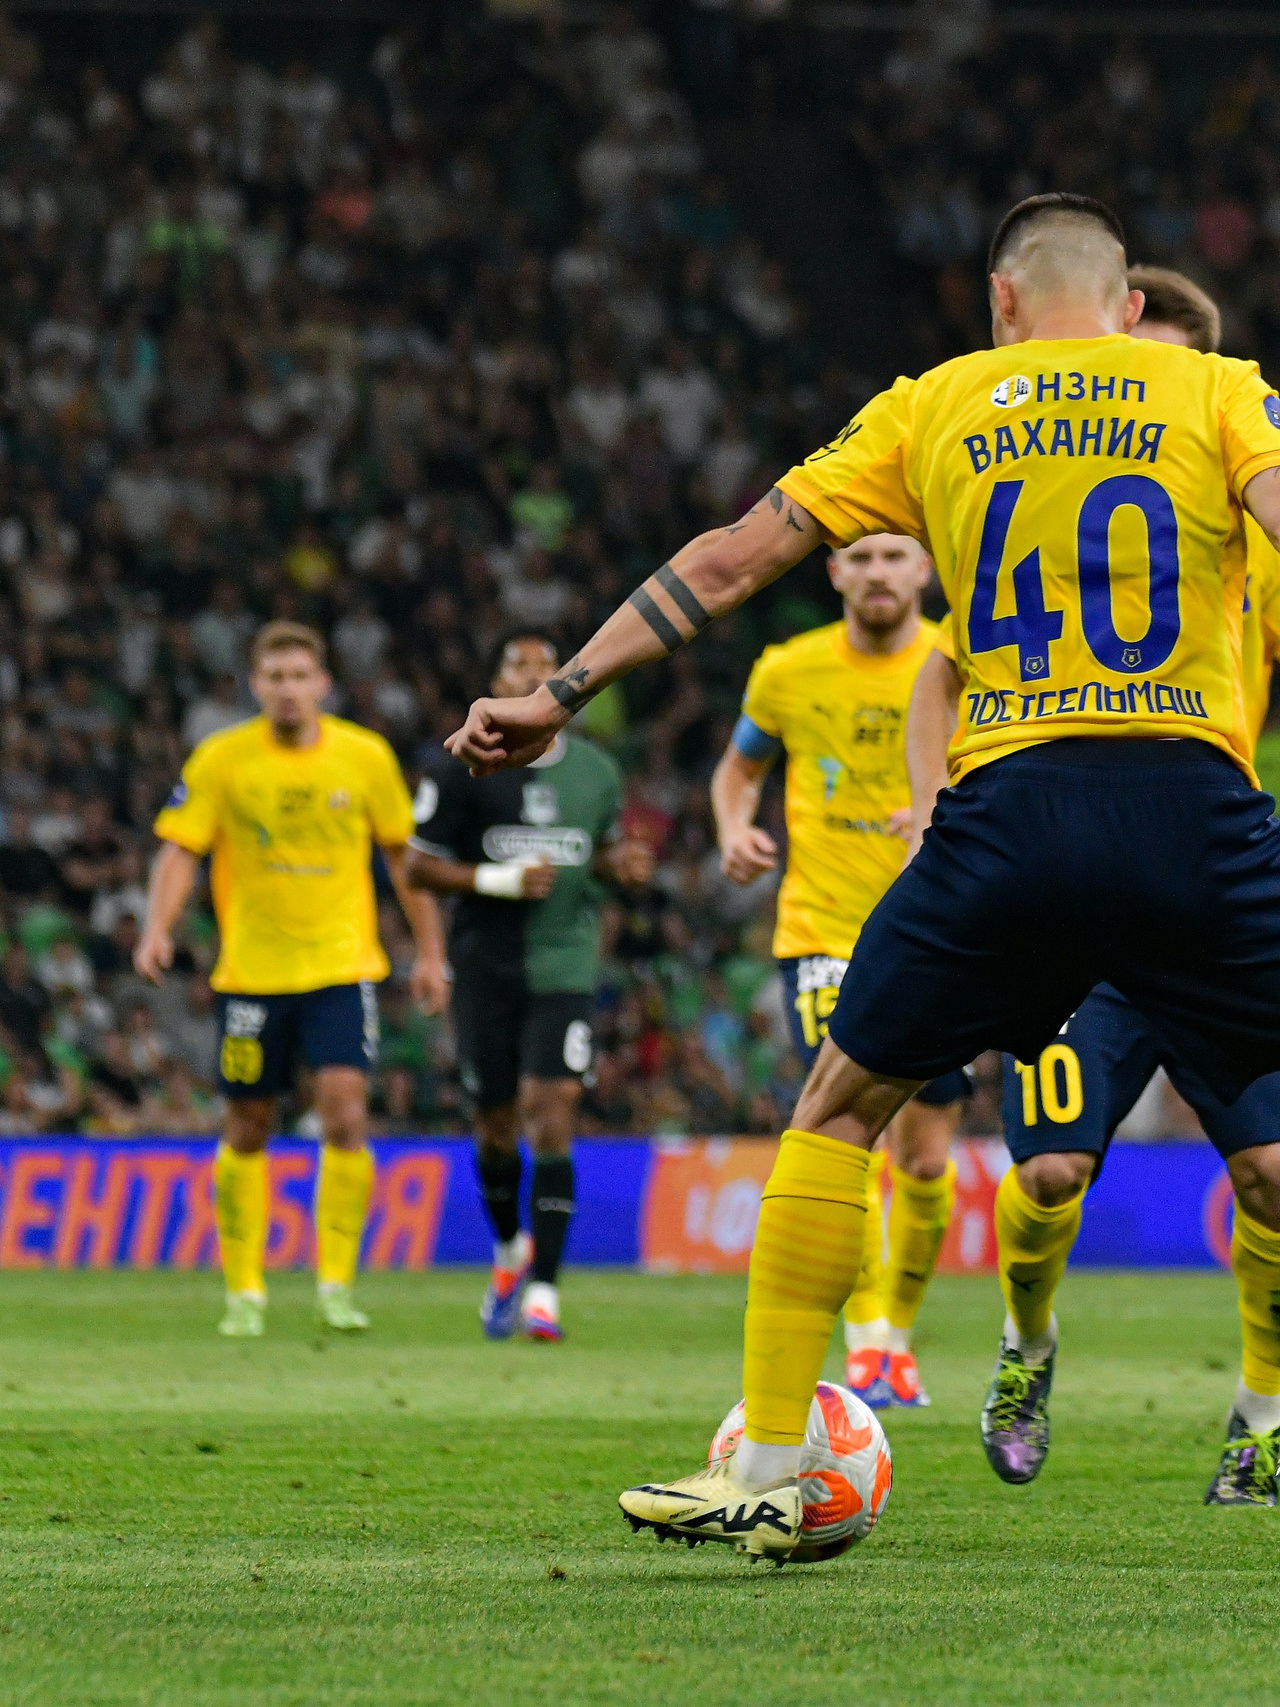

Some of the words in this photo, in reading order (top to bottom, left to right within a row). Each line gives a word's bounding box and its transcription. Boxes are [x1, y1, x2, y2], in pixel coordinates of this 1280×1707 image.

[1036, 371, 1145, 402] НЗНП
[964, 417, 1167, 473] ВАХАНИЯ
[968, 475, 1180, 682] 40
[1014, 1043, 1084, 1127] 10
